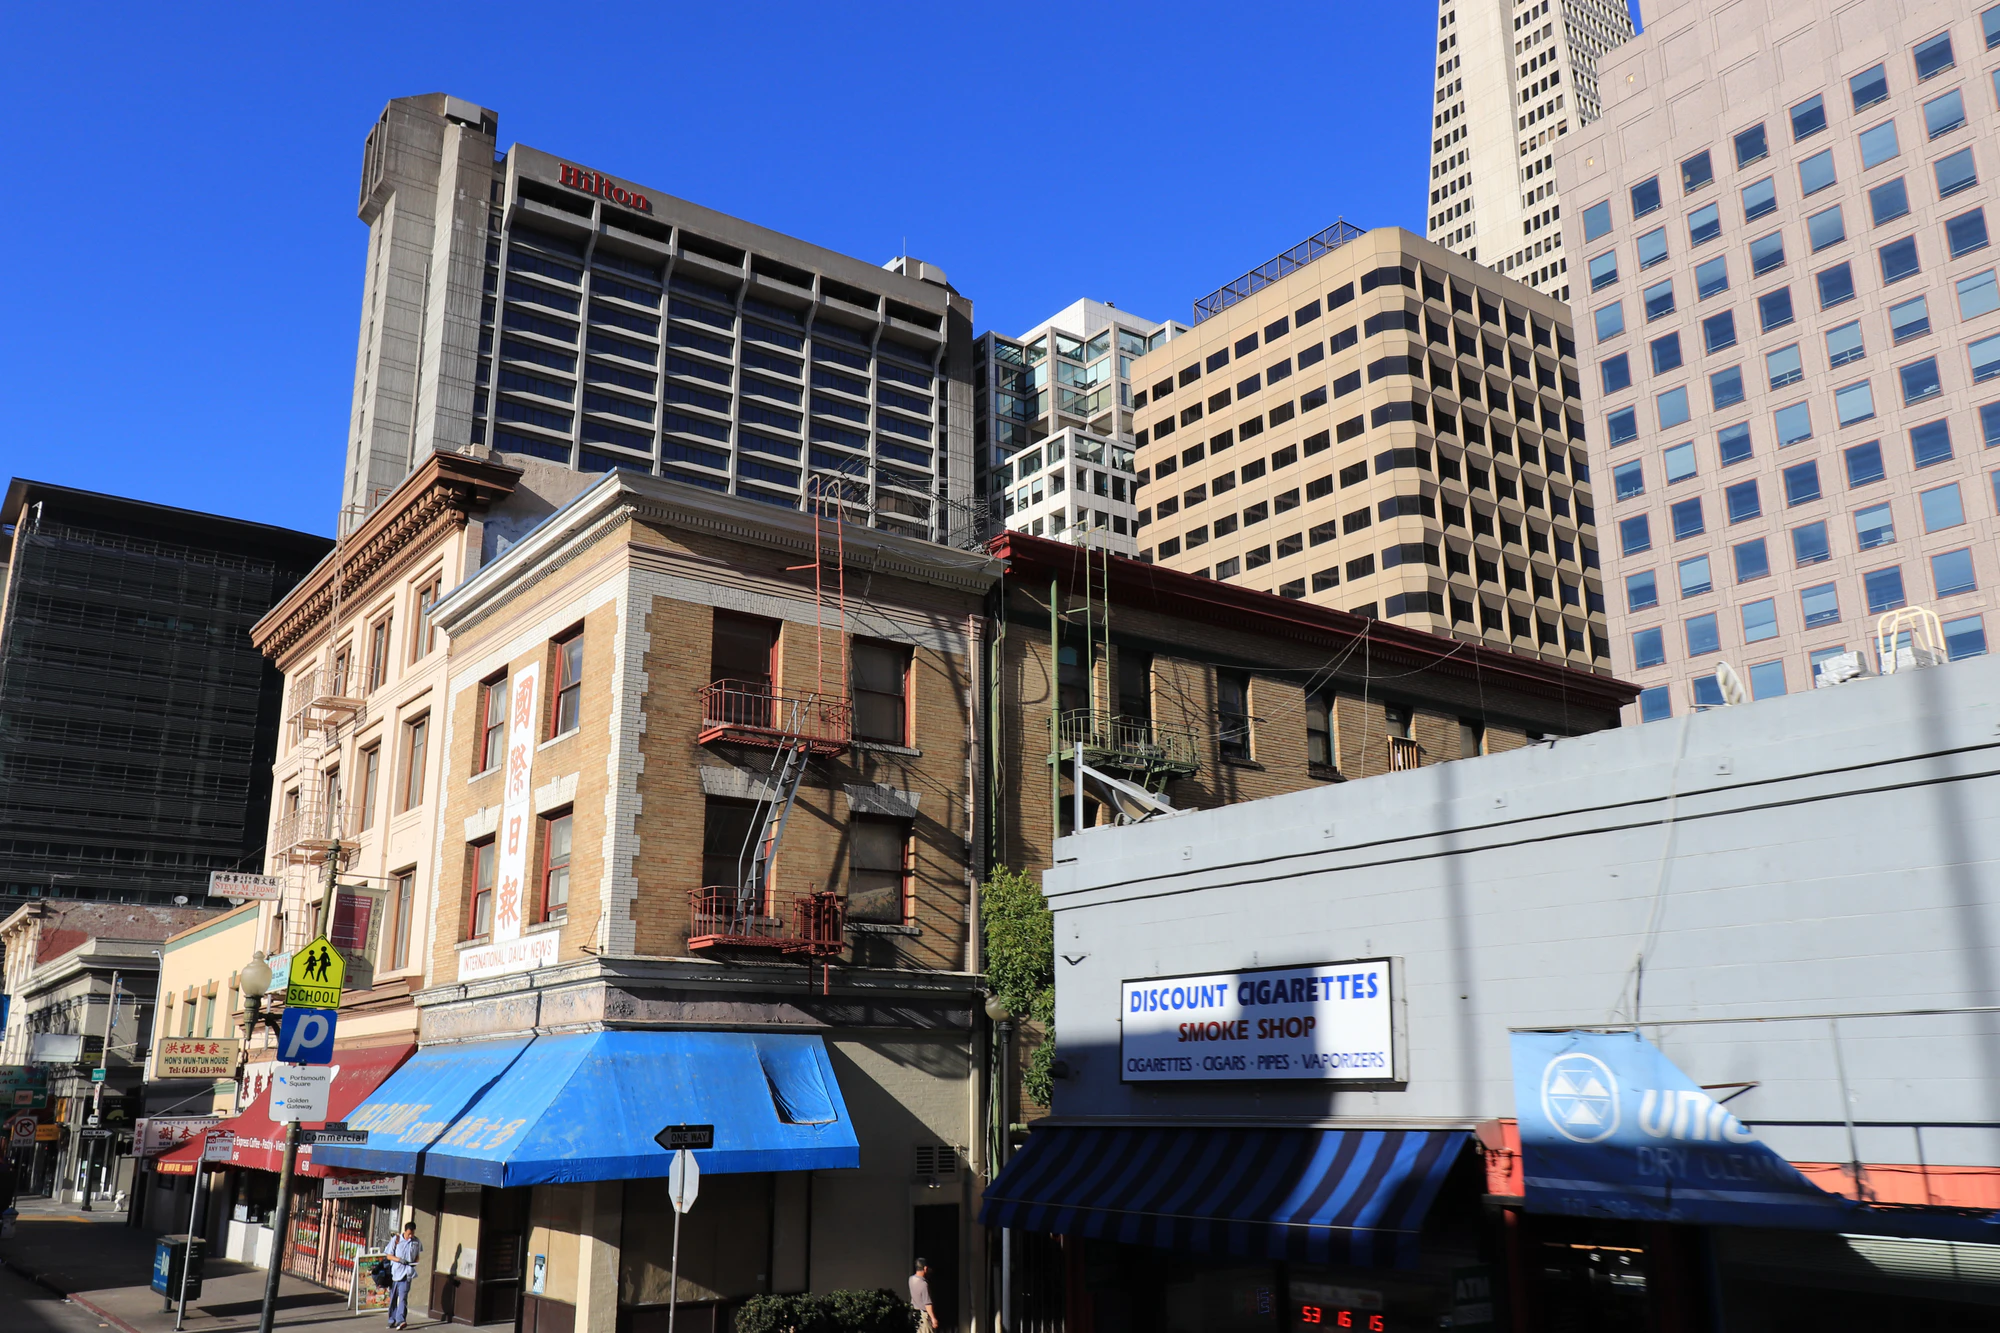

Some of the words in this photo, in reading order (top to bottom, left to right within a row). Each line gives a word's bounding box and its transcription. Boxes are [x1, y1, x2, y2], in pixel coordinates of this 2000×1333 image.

[557, 162, 648, 211] Hilton
[498, 674, 534, 931] 國際日報
[215, 881, 239, 890] STEVE
[252, 885, 276, 894] JEONG
[223, 889, 266, 897] REALTY
[464, 949, 505, 972] INTERNATIONAL
[509, 944, 528, 963] DAILY
[531, 938, 553, 959] NEWS
[289, 988, 336, 1005] SCHOOL
[1130, 983, 1228, 1013] DISCOUNT
[1237, 972, 1378, 1006] CIGARETTES
[1178, 1019, 1249, 1043] SMOKE
[1257, 1016, 1316, 1039] SHOP
[164, 1056, 182, 1064] HON'S
[183, 1056, 209, 1064] WUN-TUN
[210, 1056, 229, 1064] HOUSE
[1127, 1056, 1192, 1072] CIGARETTES
[1203, 1055, 1246, 1071] CIGARS
[1257, 1053, 1290, 1070] PIPES
[1301, 1051, 1385, 1070] VAPORIZERS
[169, 1066, 181, 1074] Tel:
[181, 1066, 198, 1074] (415)
[158, 1126, 208, 1141] 謝本
[304, 1132, 365, 1142] Commercial
[671, 1133, 688, 1143] ONE
[691, 1132, 708, 1142] WAY
[1636, 1146, 1688, 1178] DRY
[1456, 1276, 1490, 1300] ATM
[1302, 1305, 1321, 1323] 53
